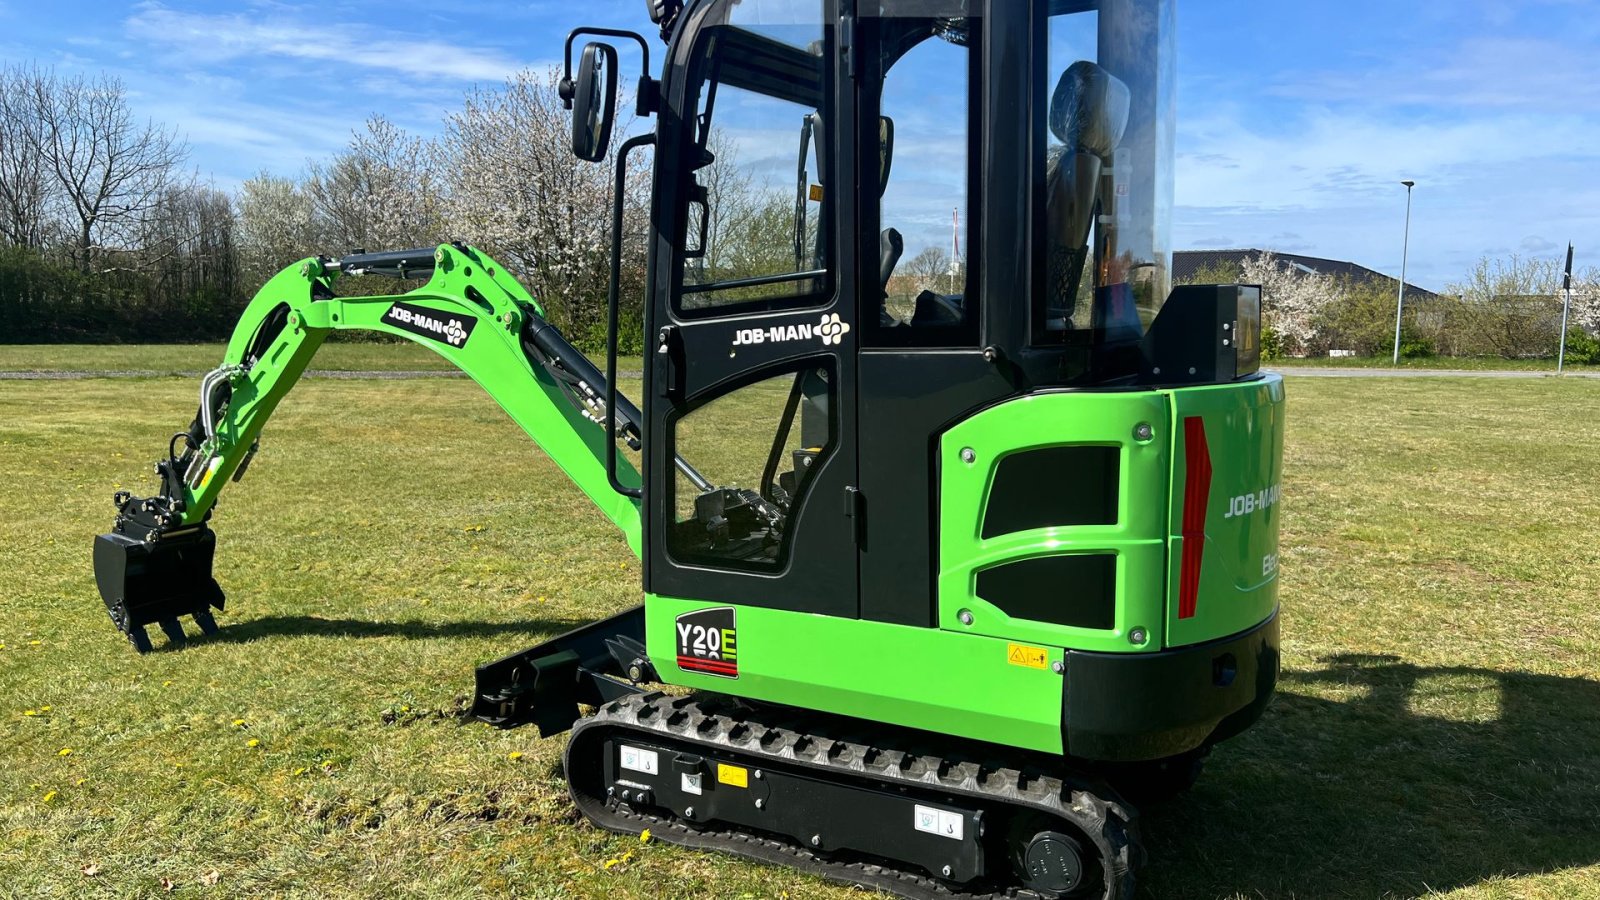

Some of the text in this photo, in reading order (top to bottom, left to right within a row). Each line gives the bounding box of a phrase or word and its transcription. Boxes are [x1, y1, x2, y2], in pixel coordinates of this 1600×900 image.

[388, 306, 443, 334] JOB-MAN
[732, 324, 812, 345] JOB-MAN
[676, 622, 737, 654] Y20E
